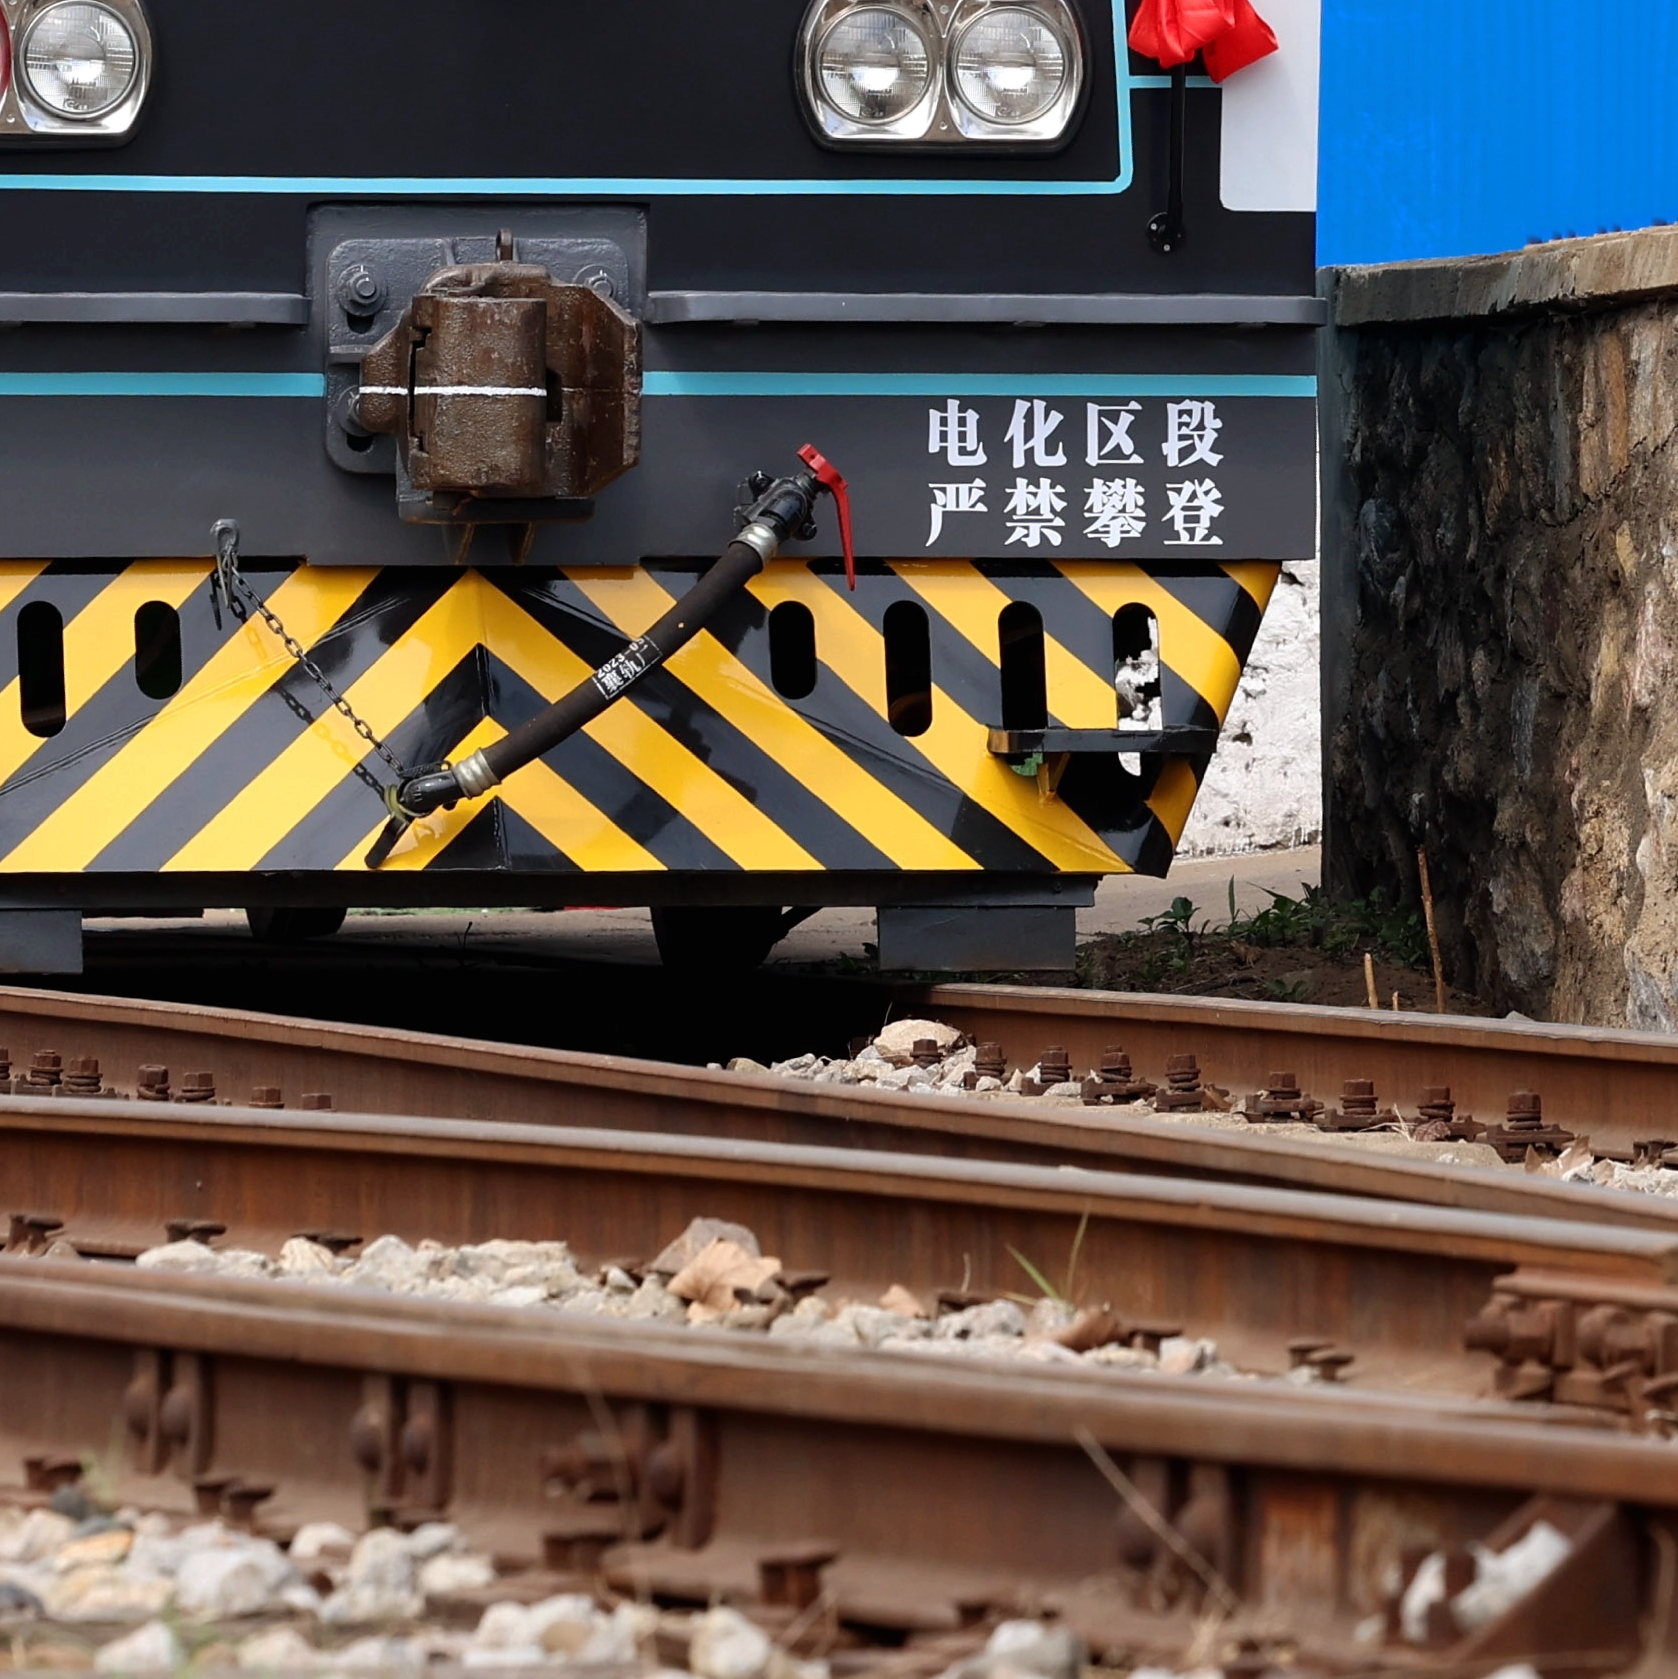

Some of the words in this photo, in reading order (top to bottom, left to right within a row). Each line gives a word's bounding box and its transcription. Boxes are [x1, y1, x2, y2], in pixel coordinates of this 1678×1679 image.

[927, 398, 1224, 468] 电化区段
[924, 477, 1225, 548] 严禁攀登
